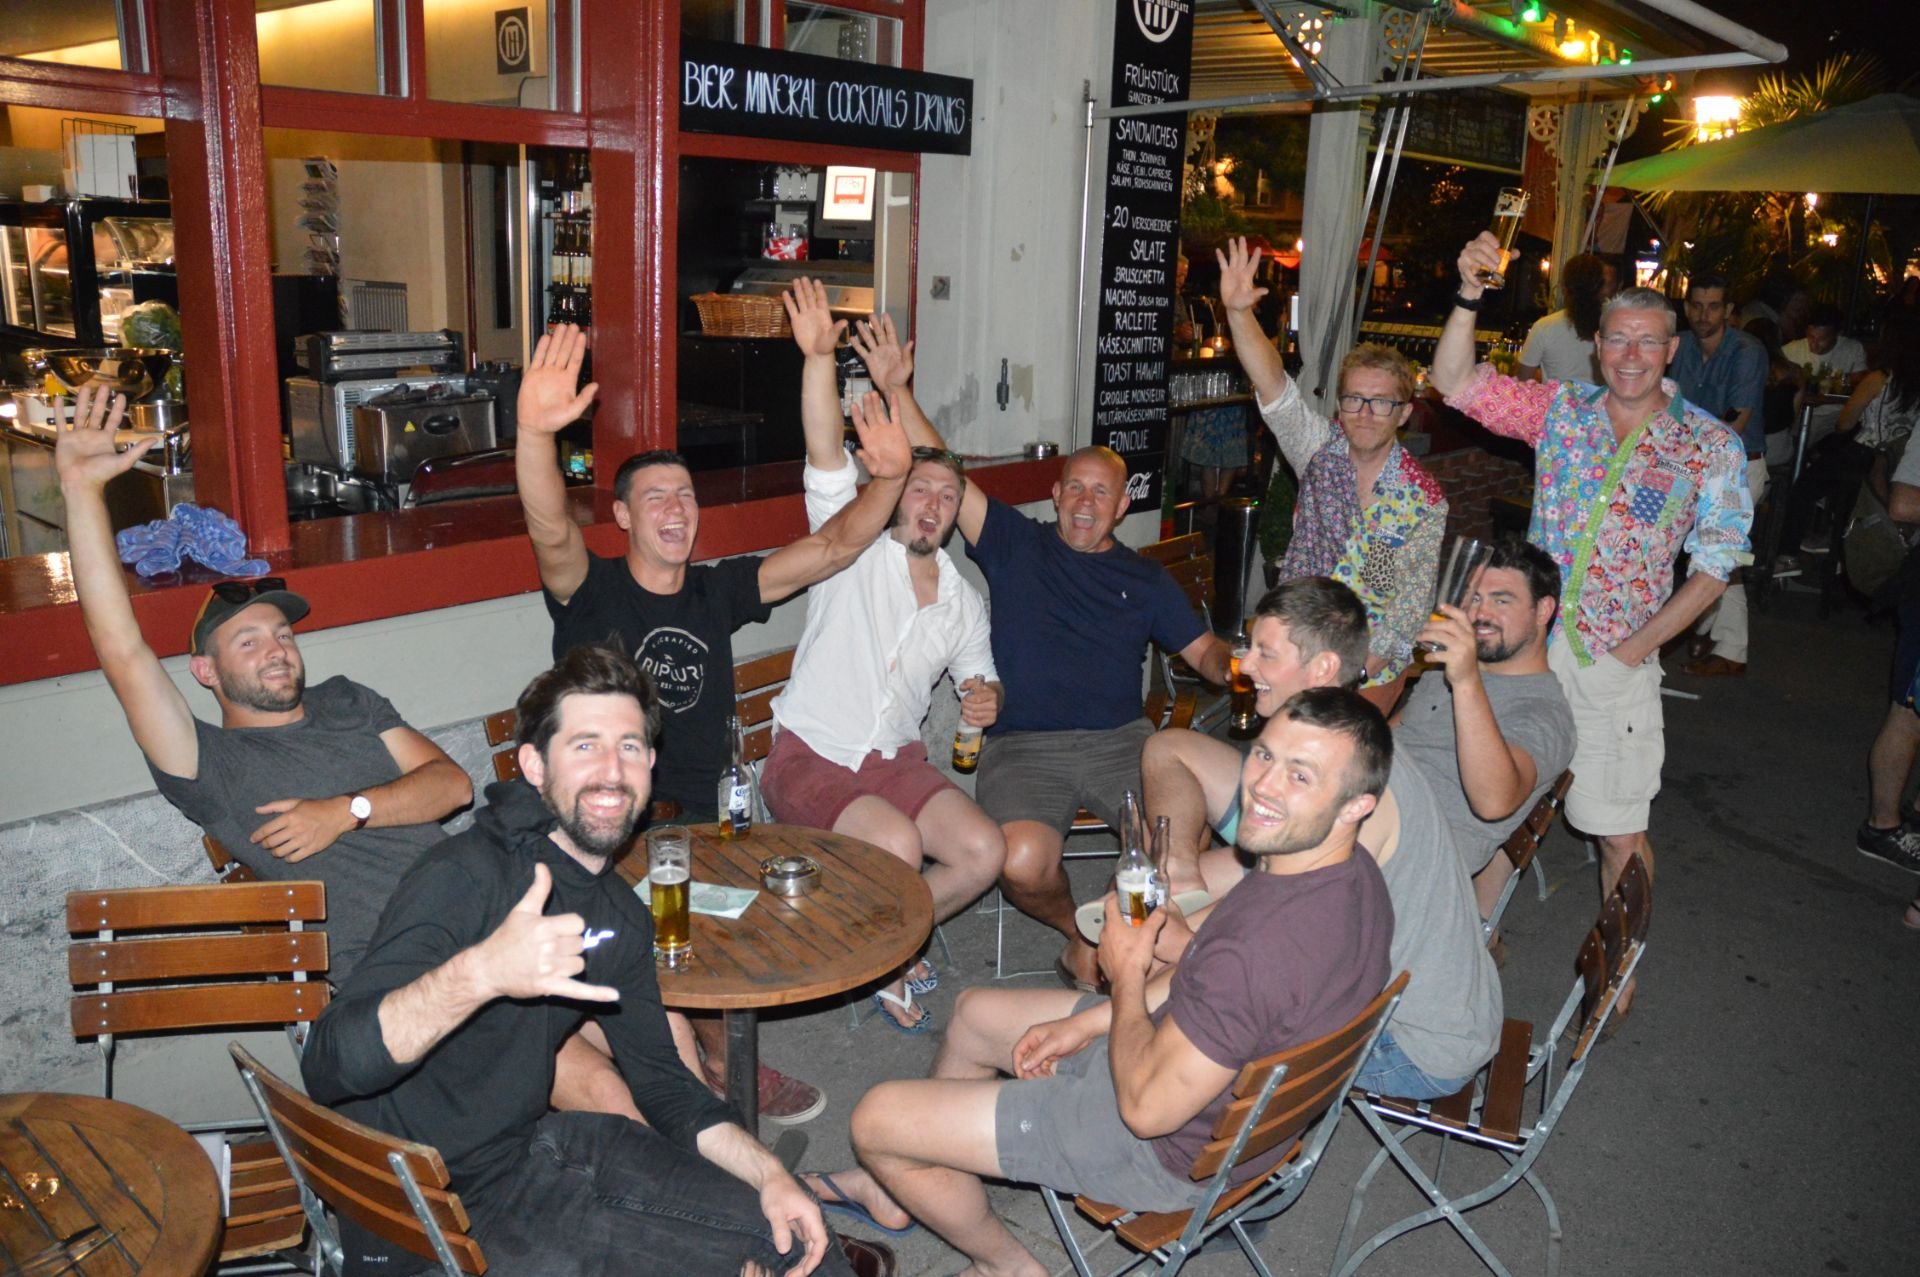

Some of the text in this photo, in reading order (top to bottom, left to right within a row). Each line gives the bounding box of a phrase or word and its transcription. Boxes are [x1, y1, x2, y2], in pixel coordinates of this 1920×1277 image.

[1125, 63, 1179, 94] FRÜHSTÜCK
[683, 60, 965, 135] BIER MINERAL COCKTAILS DRINKS
[1116, 118, 1178, 150] SANDWICHES
[1111, 205, 1129, 229] 20
[1130, 239, 1166, 263] SALATE
[1105, 288, 1137, 306] NACHOS
[1114, 311, 1159, 331] RACLETTE
[1099, 332, 1165, 355] KÄSESCHNITTEN
[1102, 361, 1165, 383] TOAST HAWAII
[1100, 388, 1166, 406] CROQUE MONSIEUR
[1108, 429, 1150, 453] FONDUE
